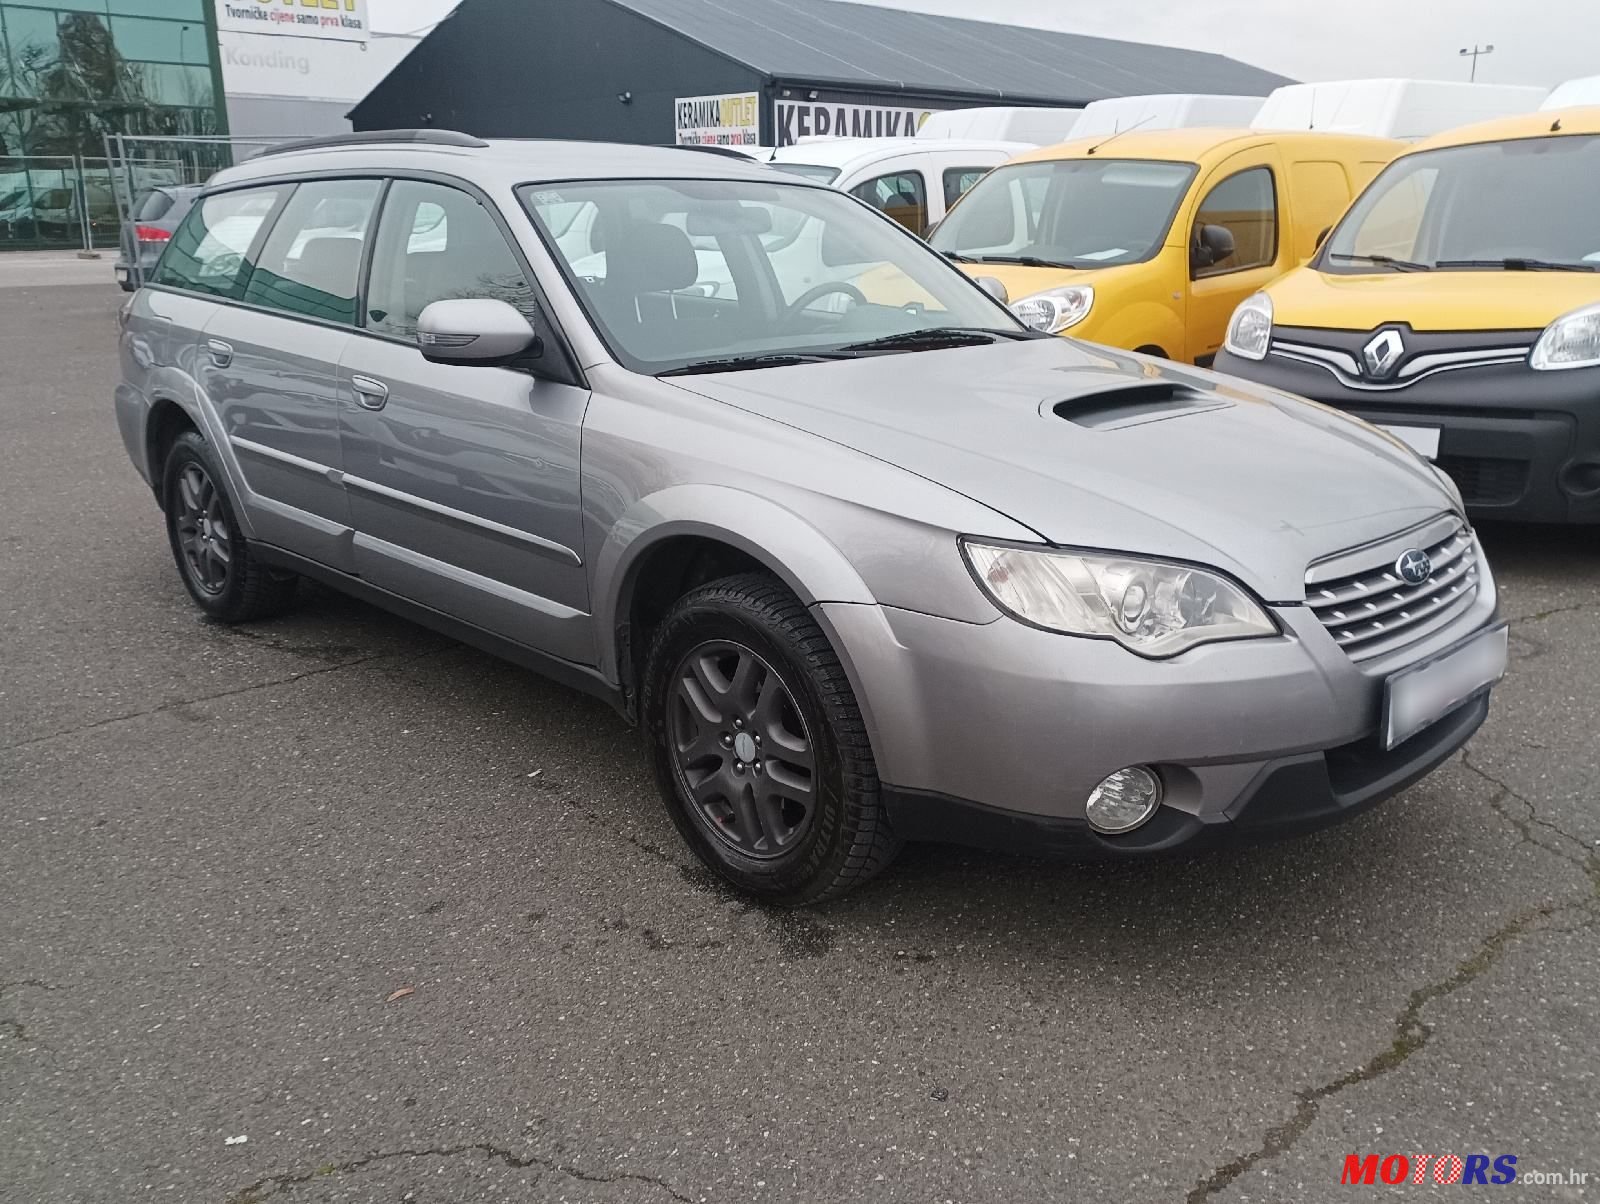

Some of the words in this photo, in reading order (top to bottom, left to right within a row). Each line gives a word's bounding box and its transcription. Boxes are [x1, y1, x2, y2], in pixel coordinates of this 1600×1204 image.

[225, 4, 268, 21] Tvorničke
[269, 9, 295, 25] cijene
[296, 13, 319, 25] samo
[320, 15, 339, 28] prva
[341, 16, 362, 30] klasa
[226, 49, 310, 74] Konding
